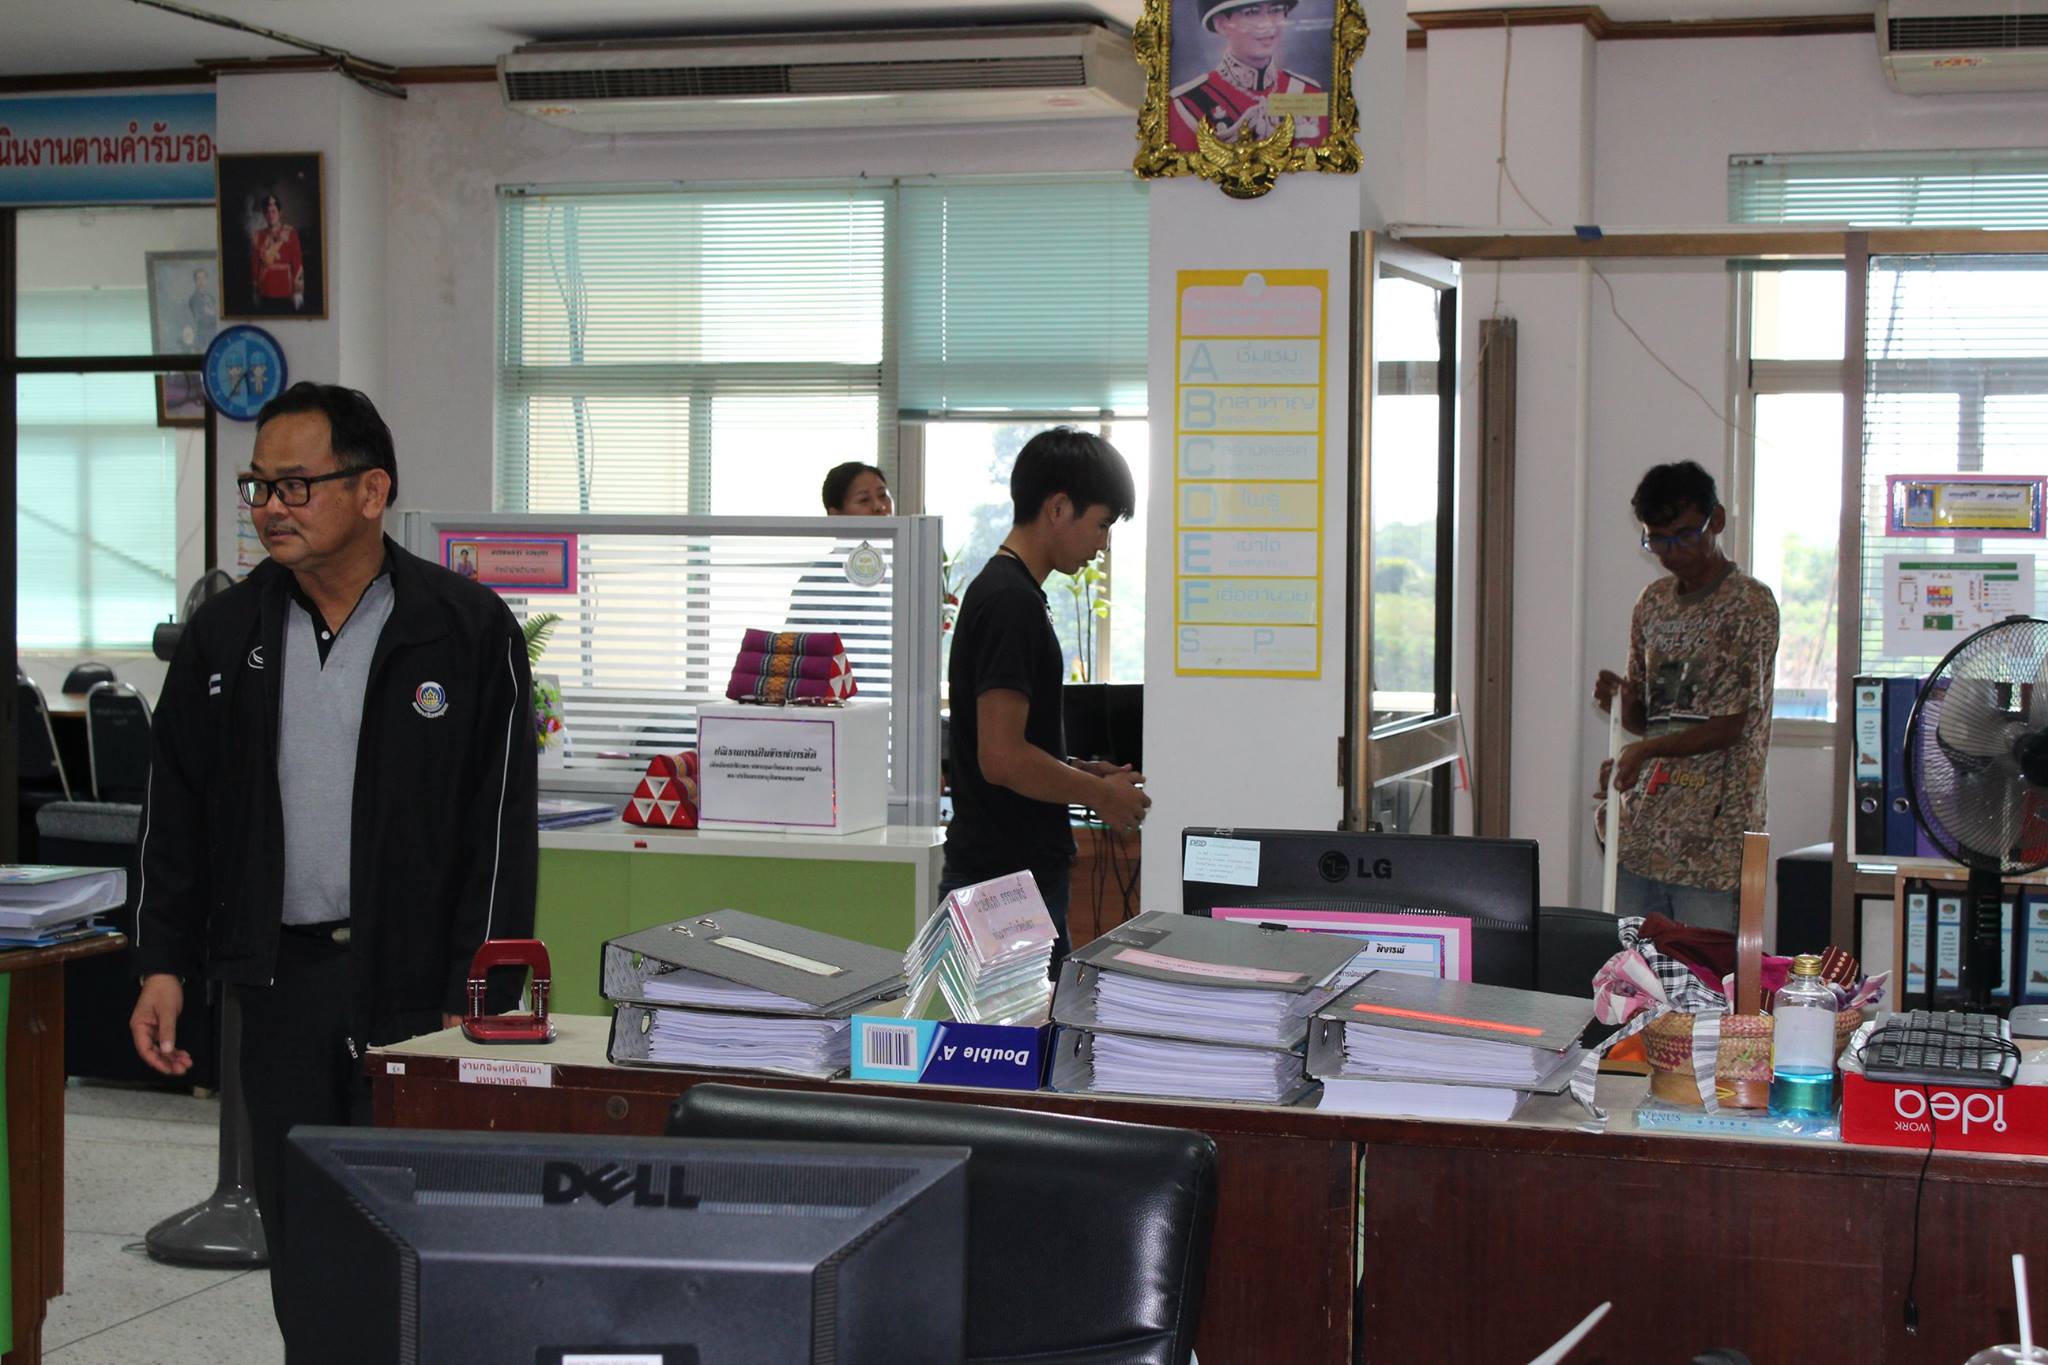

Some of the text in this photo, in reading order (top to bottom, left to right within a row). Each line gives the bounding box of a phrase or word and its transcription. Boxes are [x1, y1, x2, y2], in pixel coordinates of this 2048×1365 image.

[1184, 342, 1219, 382] A
[1184, 389, 1217, 429] B
[1184, 437, 1216, 476] C
[1183, 485, 1216, 525] D
[1183, 533, 1212, 573] E
[1183, 581, 1211, 620] F
[1180, 627, 1275, 654] S P
[1357, 858, 1392, 880] LG
[943, 1045, 1030, 1066] Double A
[1642, 1110, 1681, 1122] VENUS
[1894, 1088, 2008, 1135] idea WORK
[543, 1161, 699, 1209] DELL
